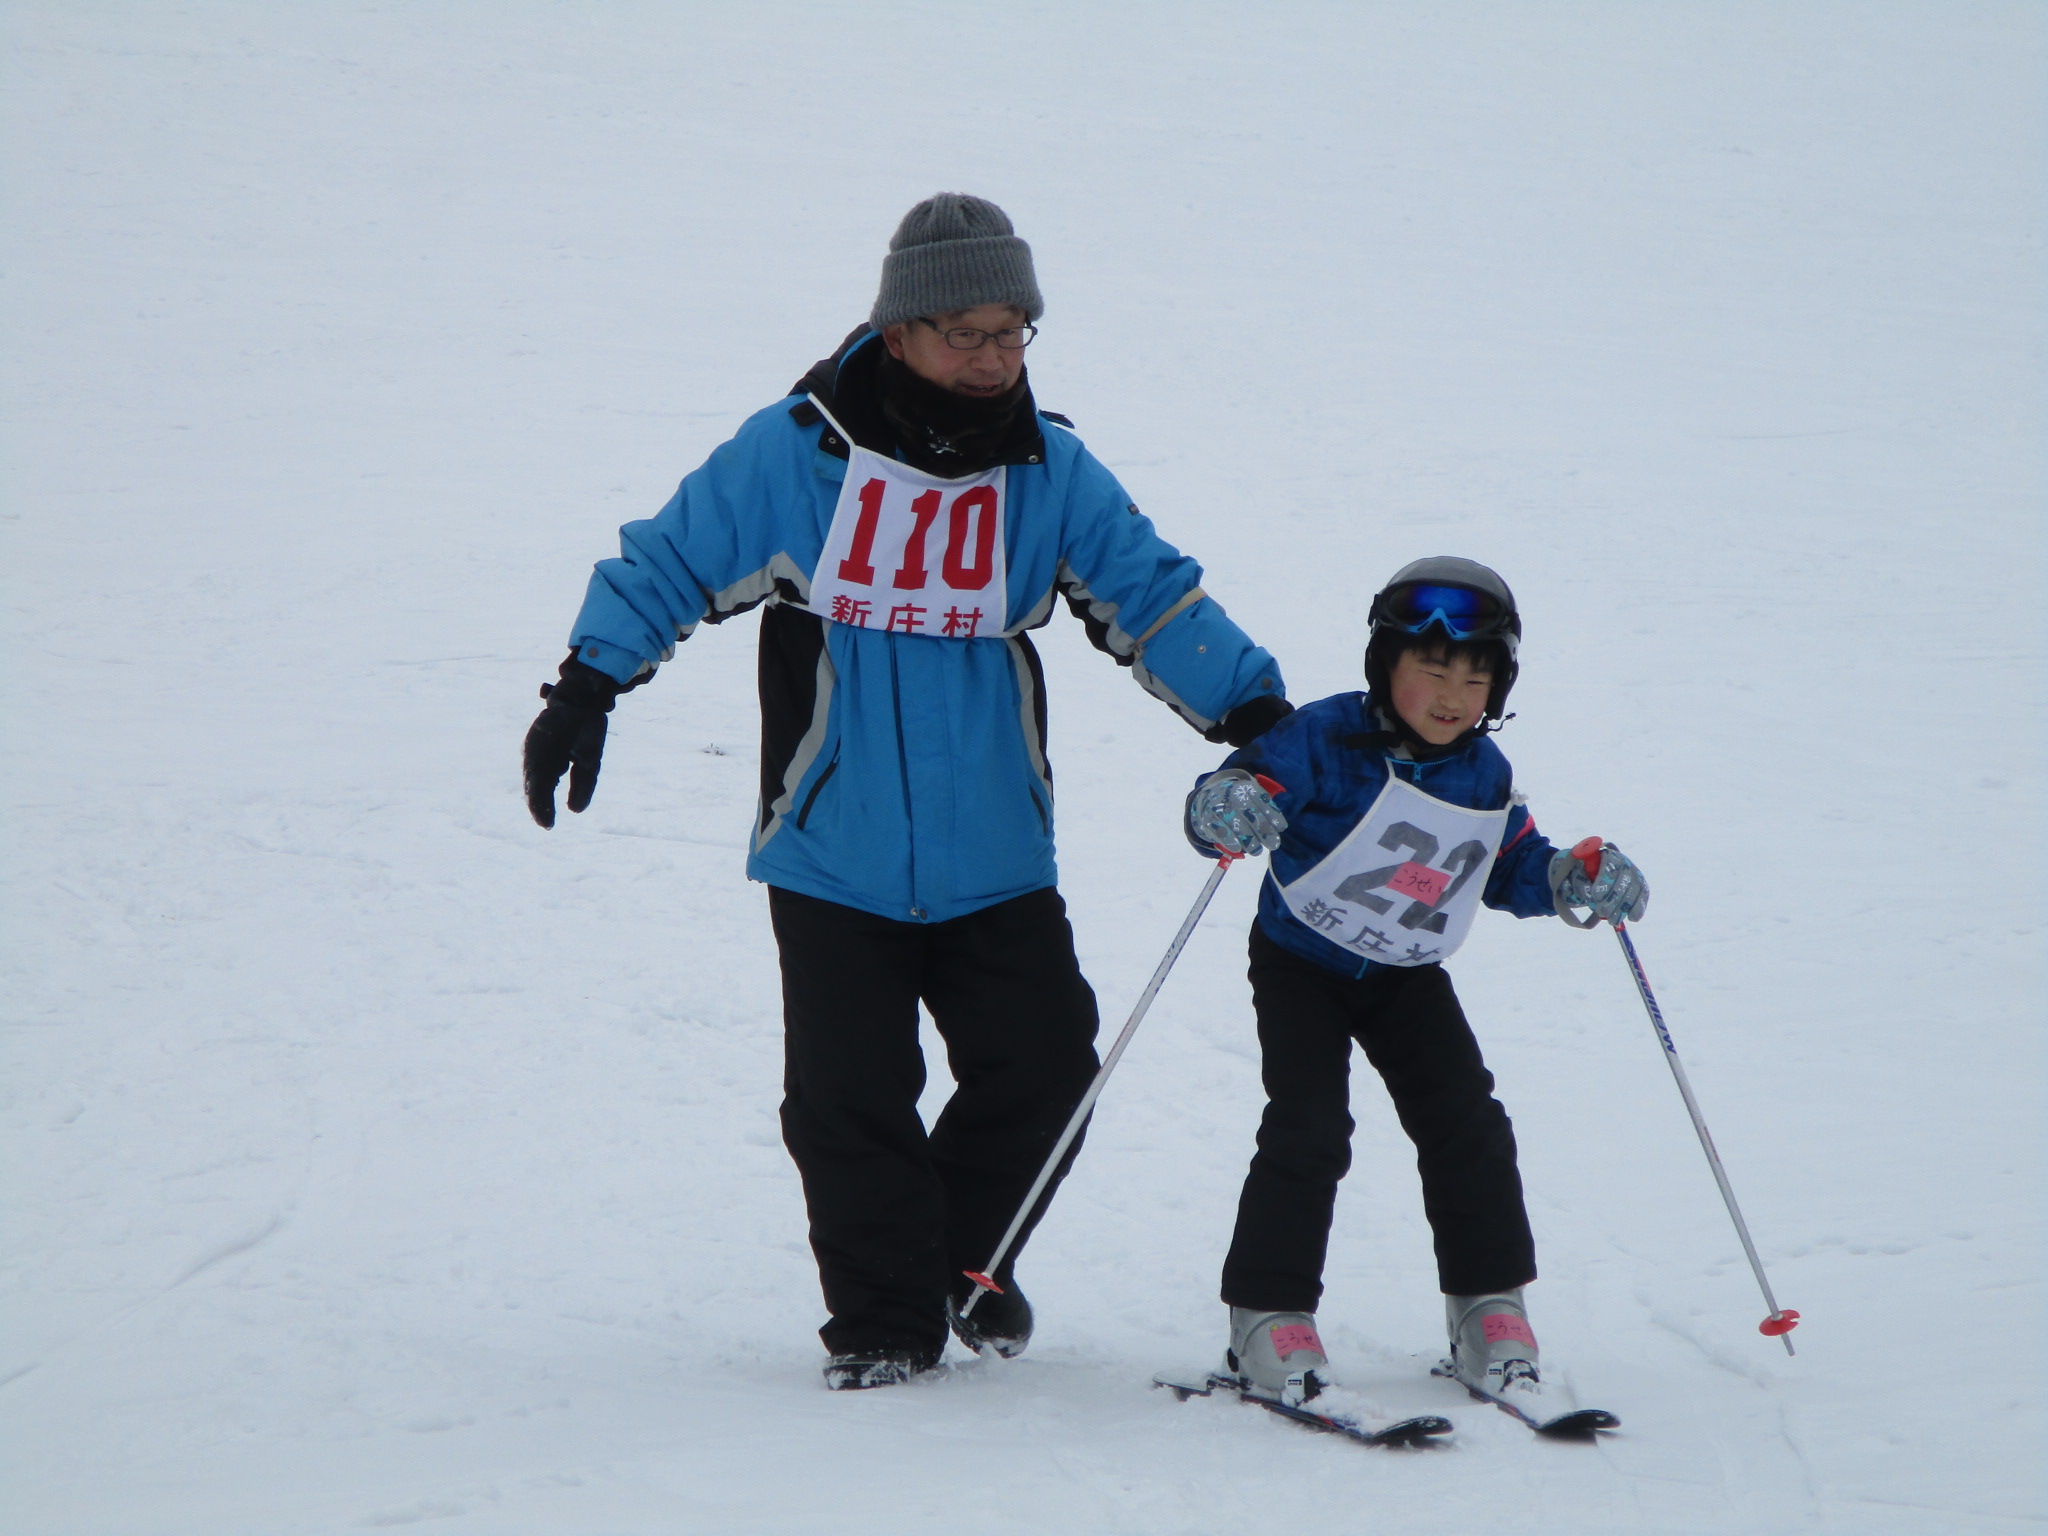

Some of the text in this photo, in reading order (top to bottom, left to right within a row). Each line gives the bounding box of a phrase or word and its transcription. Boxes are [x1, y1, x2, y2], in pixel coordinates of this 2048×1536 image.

[838, 477, 998, 590] 110
[831, 594, 984, 638] 新庄村
[1333, 820, 1488, 935] 22
